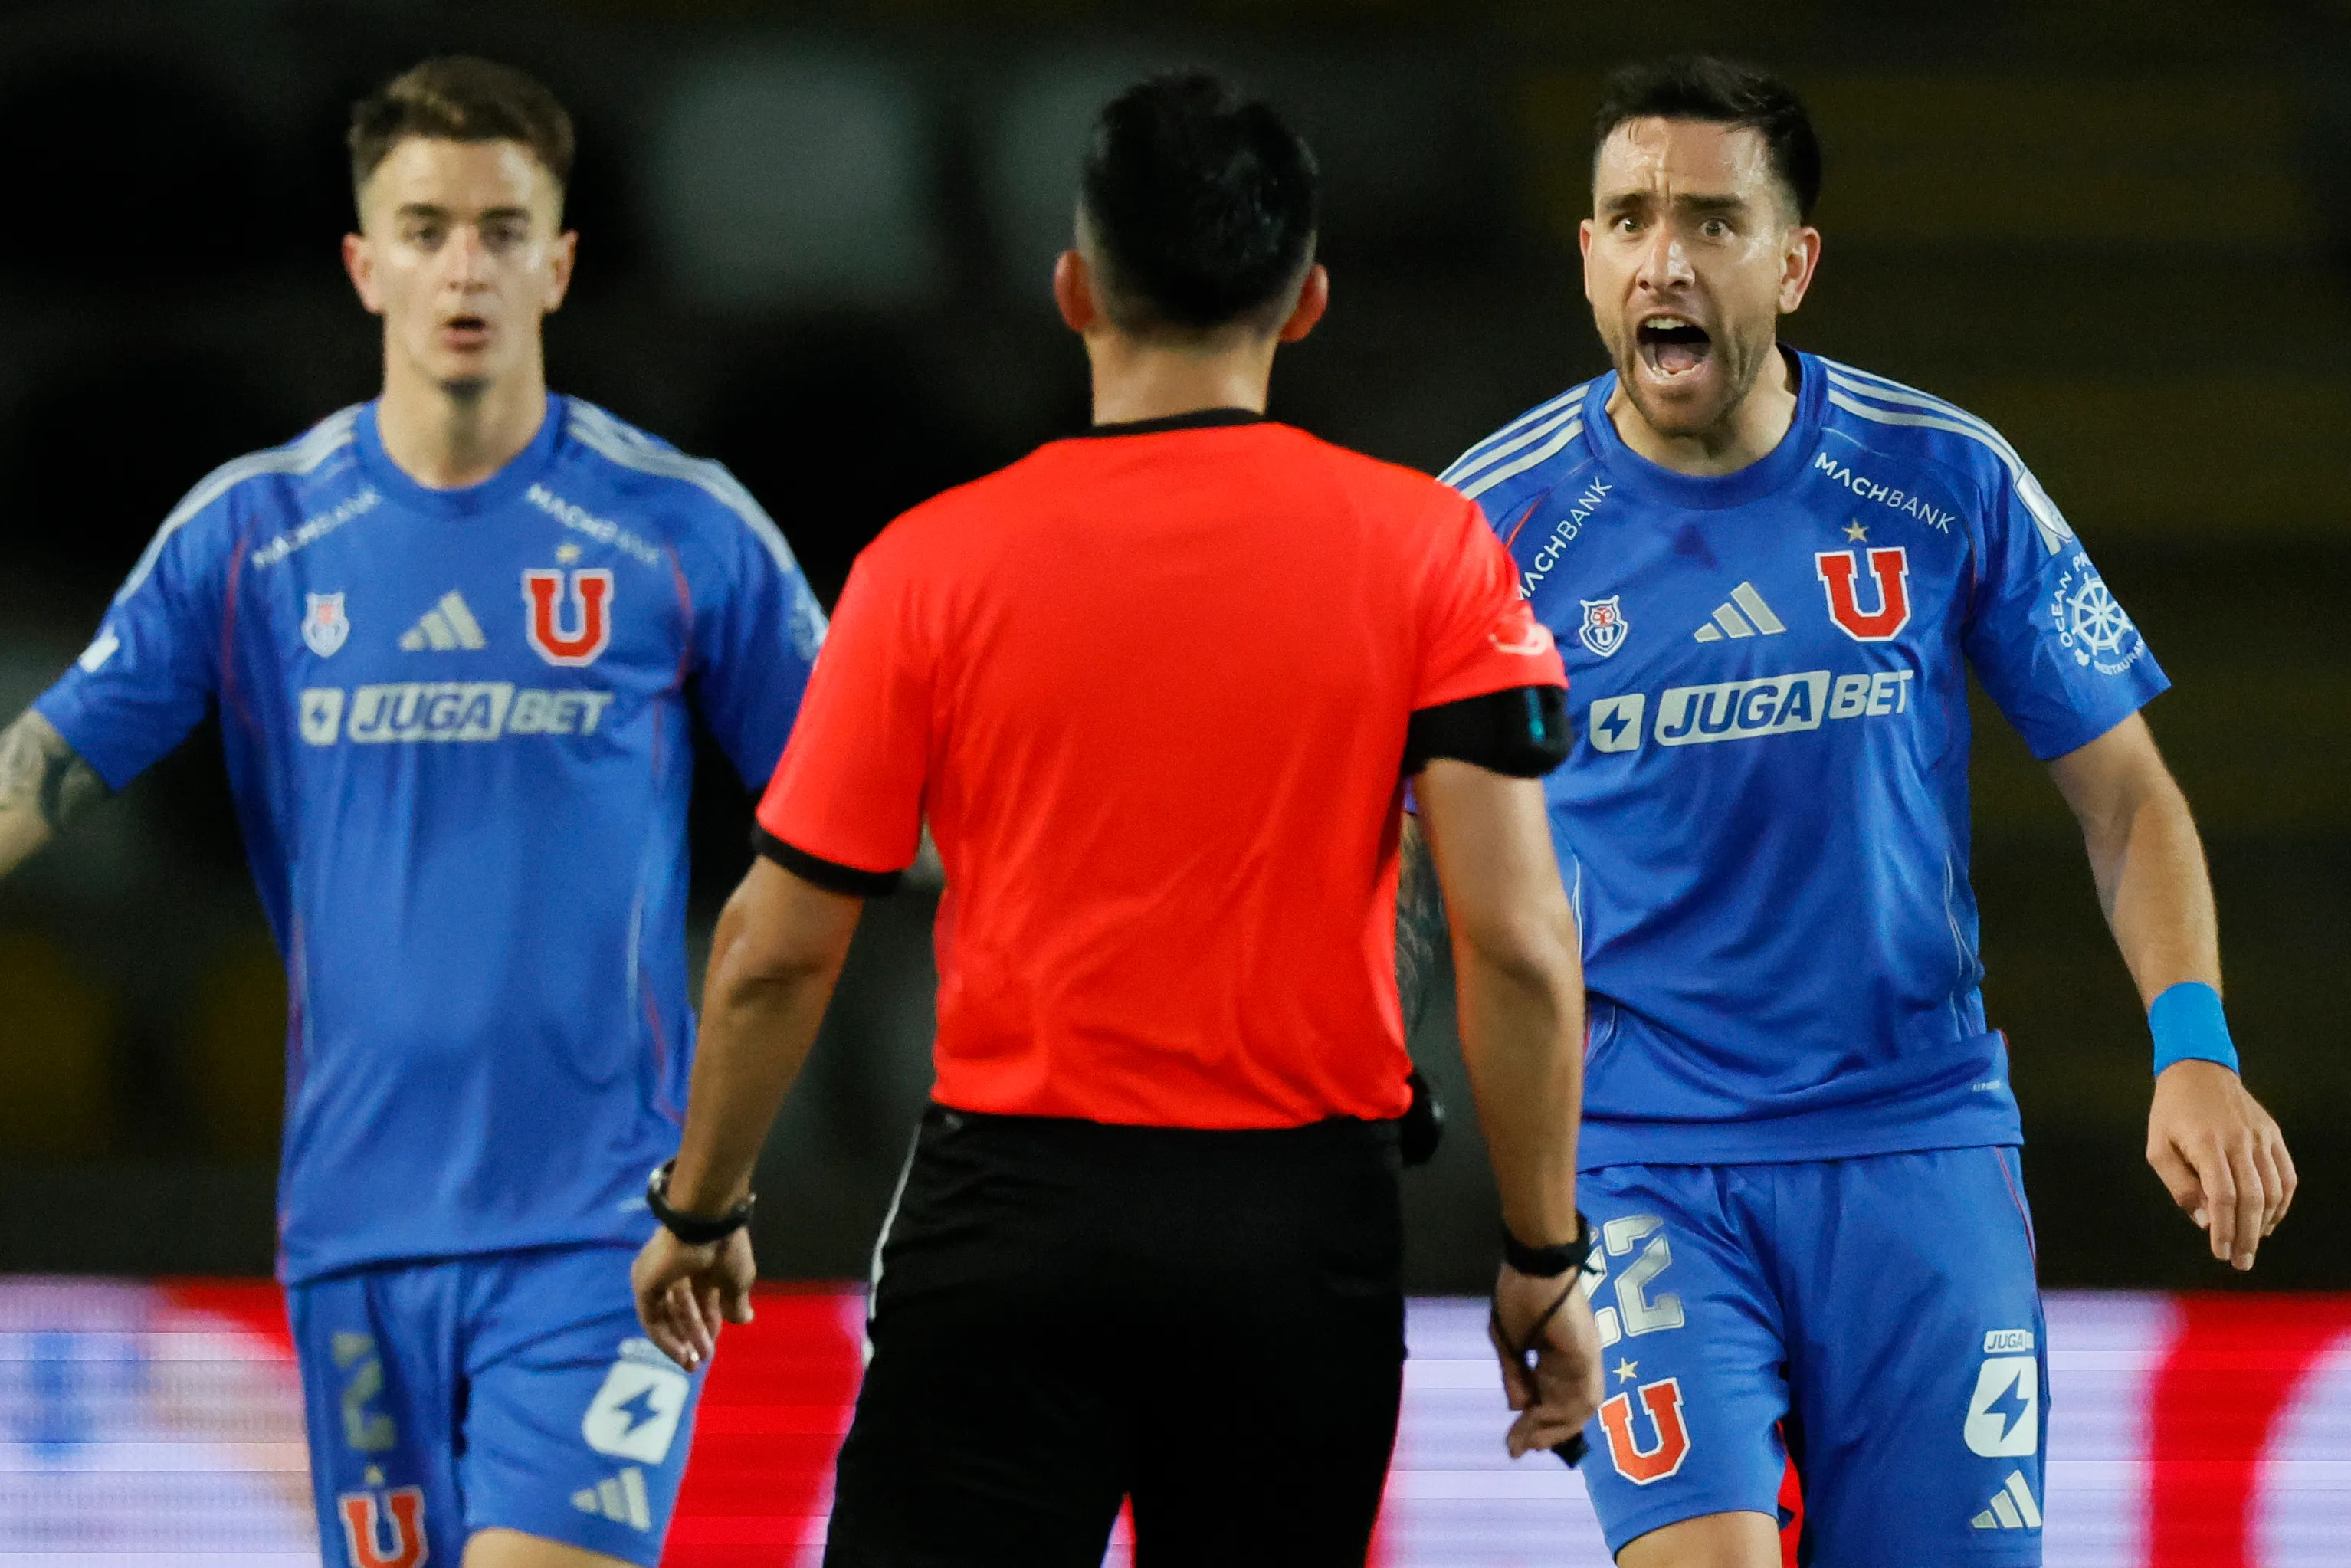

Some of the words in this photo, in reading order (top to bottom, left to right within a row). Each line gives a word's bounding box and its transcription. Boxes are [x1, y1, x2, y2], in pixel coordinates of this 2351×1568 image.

[1815, 451, 1956, 534] MACHBANK
[523, 568, 615, 668] U
[1815, 546, 1911, 643] U
[2051, 571, 2074, 648] OCEAN
[1597, 1377, 1691, 1485] U
[338, 1488, 428, 1568] U
